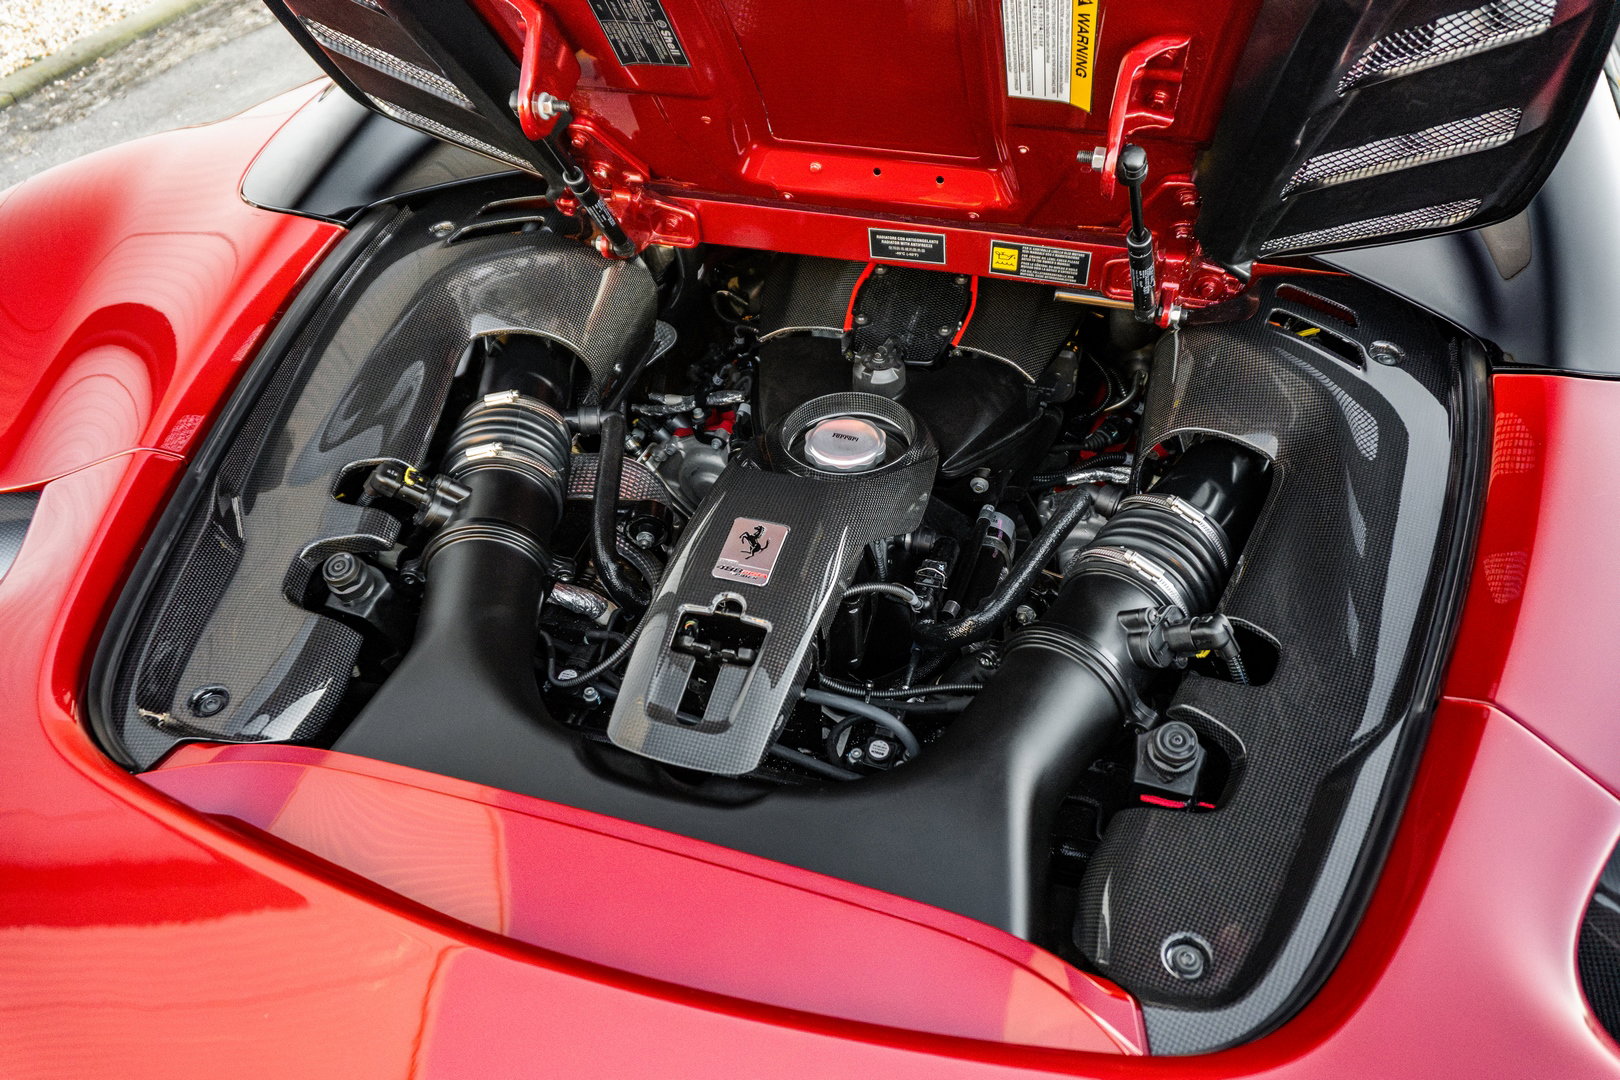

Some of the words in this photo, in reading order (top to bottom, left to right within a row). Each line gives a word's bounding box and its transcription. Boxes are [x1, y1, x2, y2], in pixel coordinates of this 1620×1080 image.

[661, 30, 681, 56] Shell
[1076, 14, 1090, 78] WARNING
[832, 432, 859, 442] Ferrari
